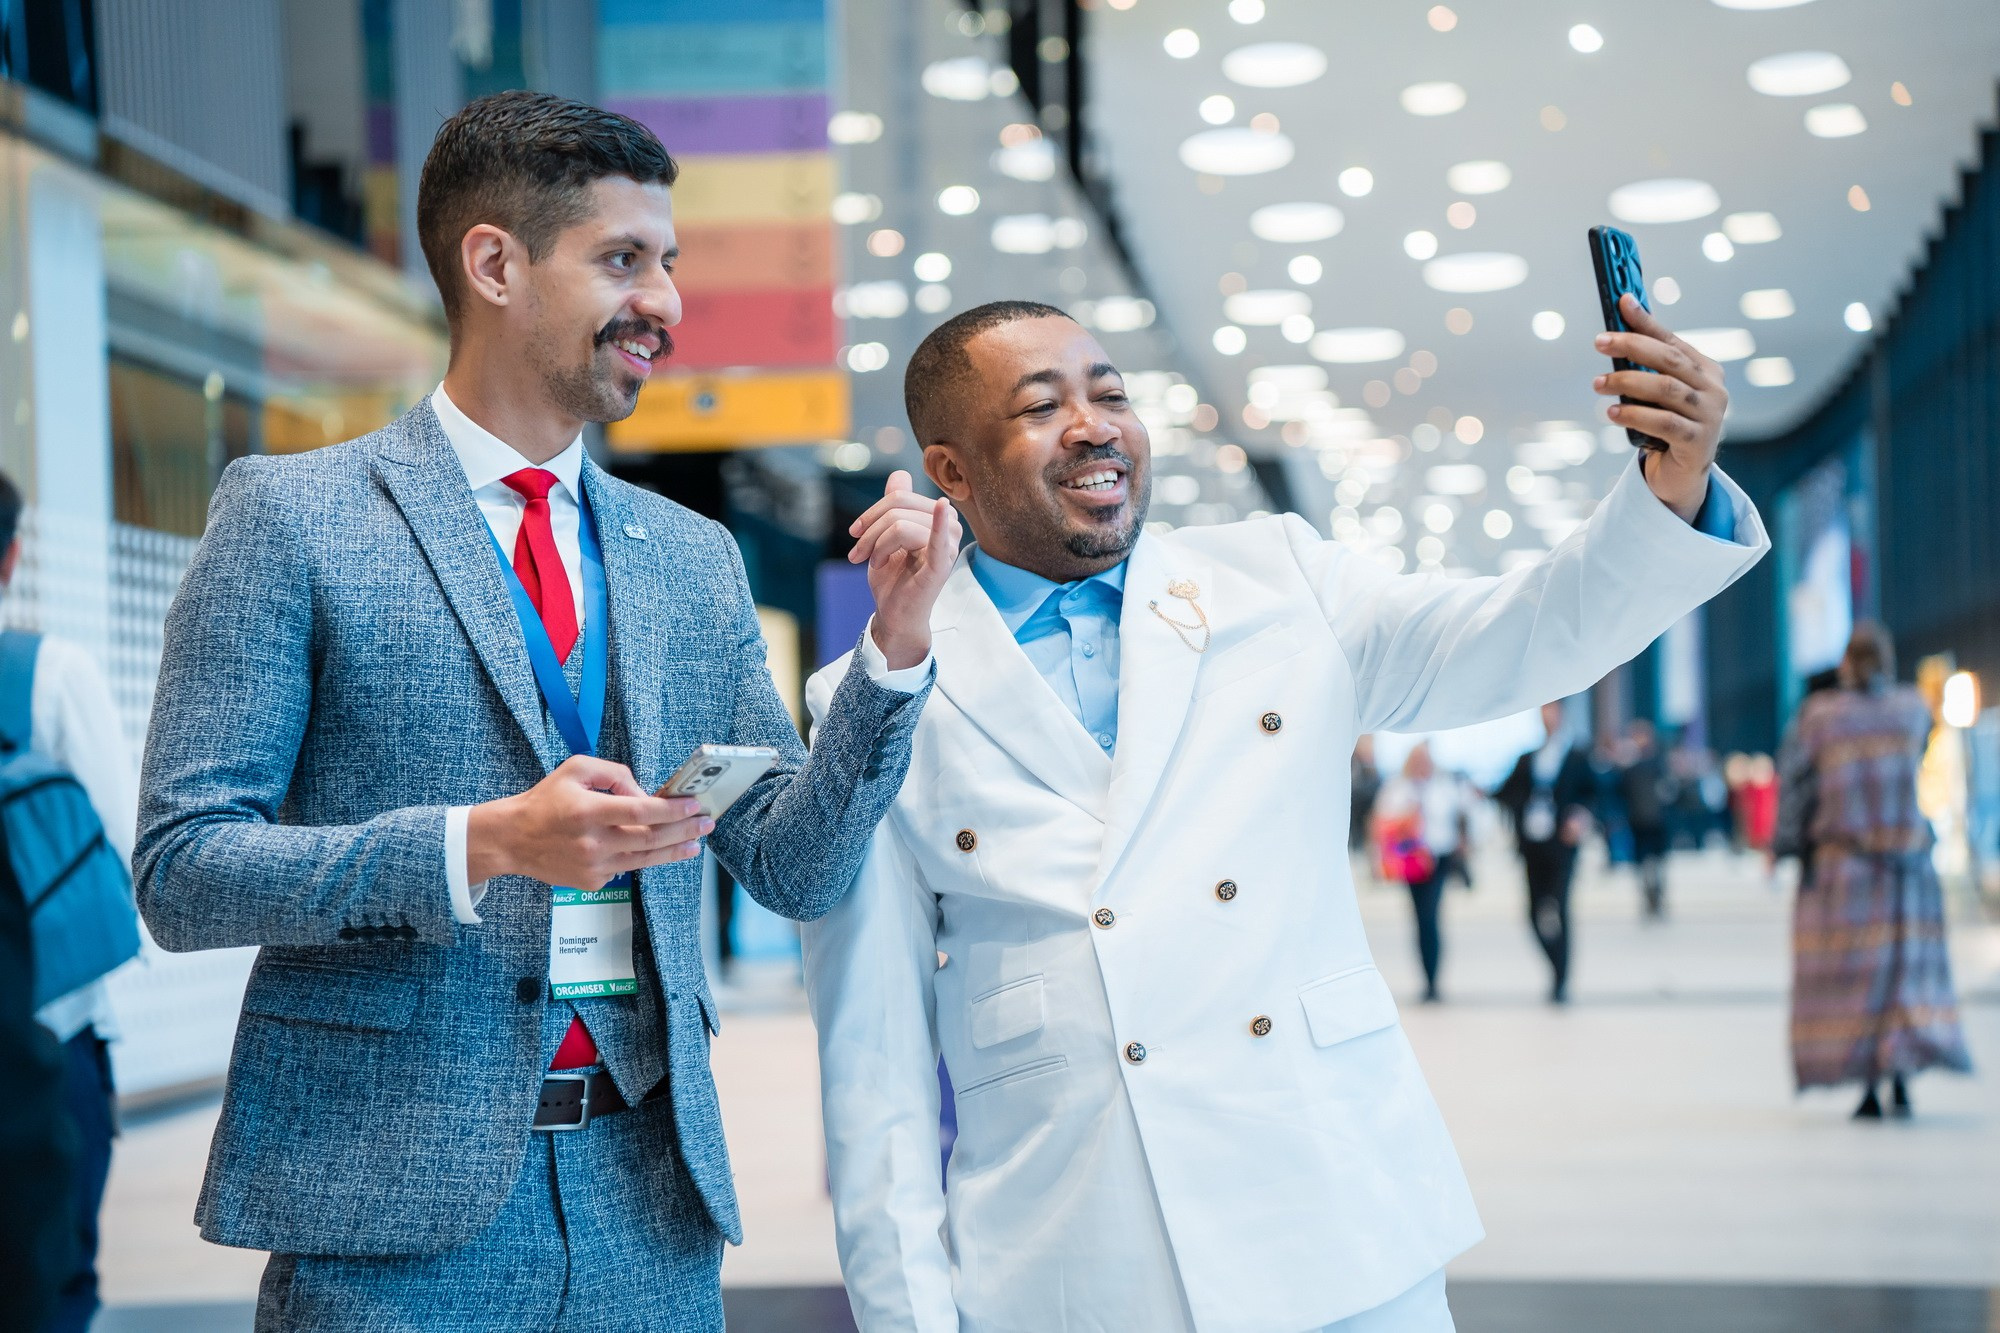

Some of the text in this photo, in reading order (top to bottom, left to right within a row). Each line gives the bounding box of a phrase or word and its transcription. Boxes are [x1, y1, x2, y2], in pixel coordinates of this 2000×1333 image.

[581, 890, 629, 901] ORGANISER
[559, 936, 598, 946] Domingues
[559, 946, 588, 955] Henrique
[555, 984, 605, 996] ORGANISER
